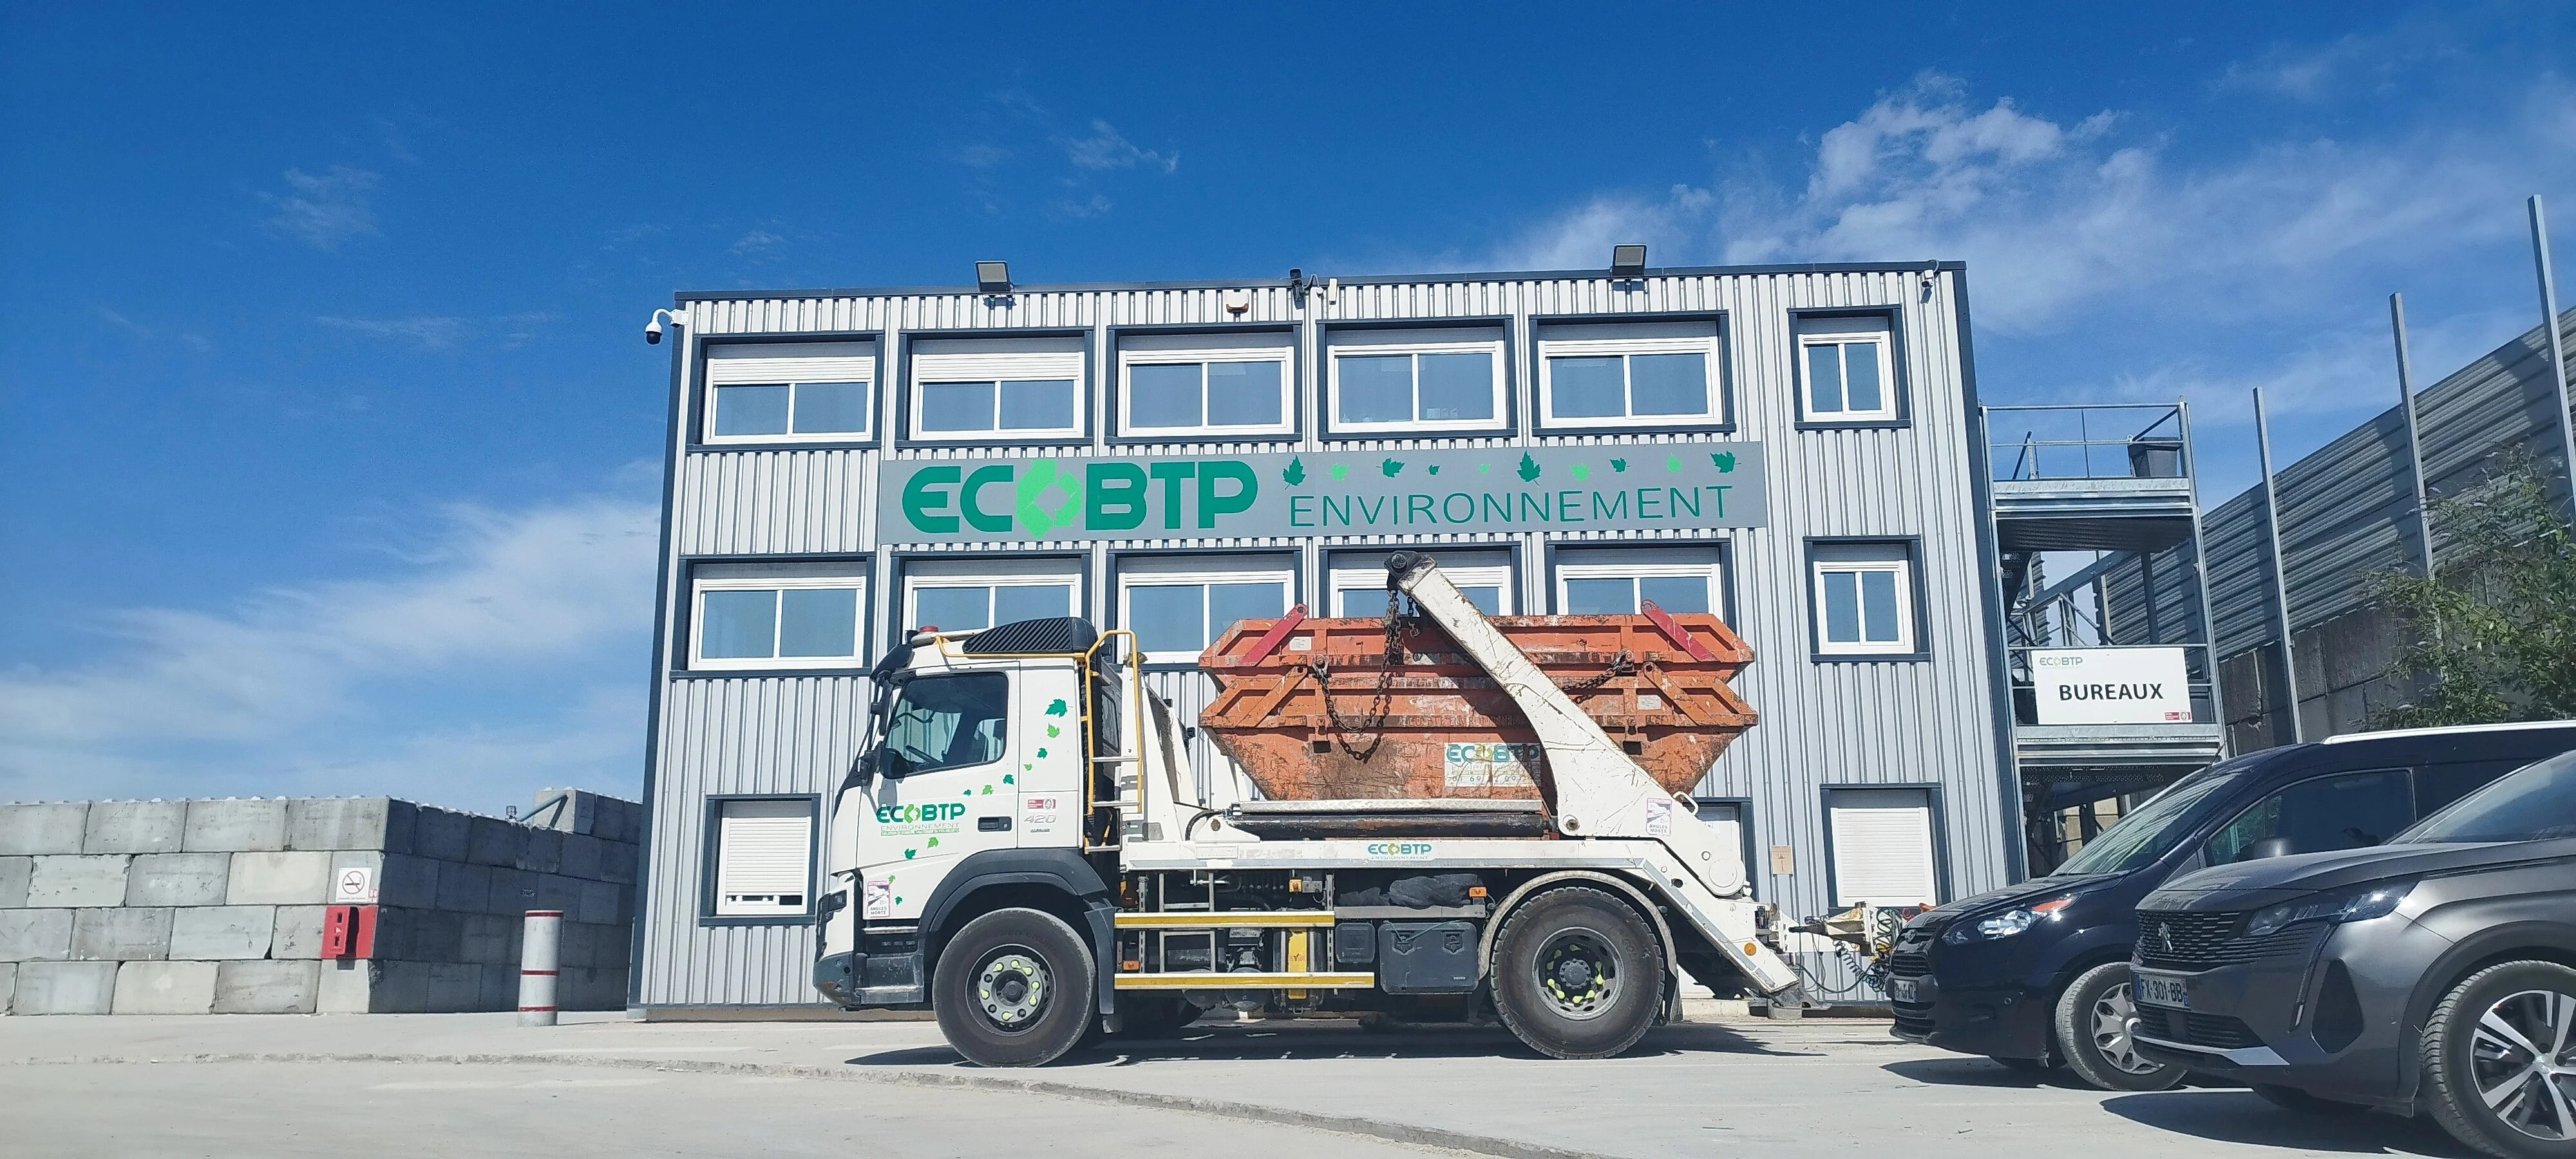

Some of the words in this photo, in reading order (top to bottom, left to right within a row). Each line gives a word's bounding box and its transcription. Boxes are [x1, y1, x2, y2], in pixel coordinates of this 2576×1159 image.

[902, 459, 1258, 540] ECOBTP
[1289, 485, 1733, 527] ENVIRONNEMENT
[2039, 657, 2083, 666] ECOBTP
[2058, 683, 2164, 701] BUREAUX
[876, 803, 965, 824] ECOBTP
[1024, 815, 1056, 823] 420
[880, 822, 960, 831] ENVIRONNEMENT
[1368, 843, 1432, 856] ECOBTP
[2140, 978, 2183, 1003] FX-301-BB
